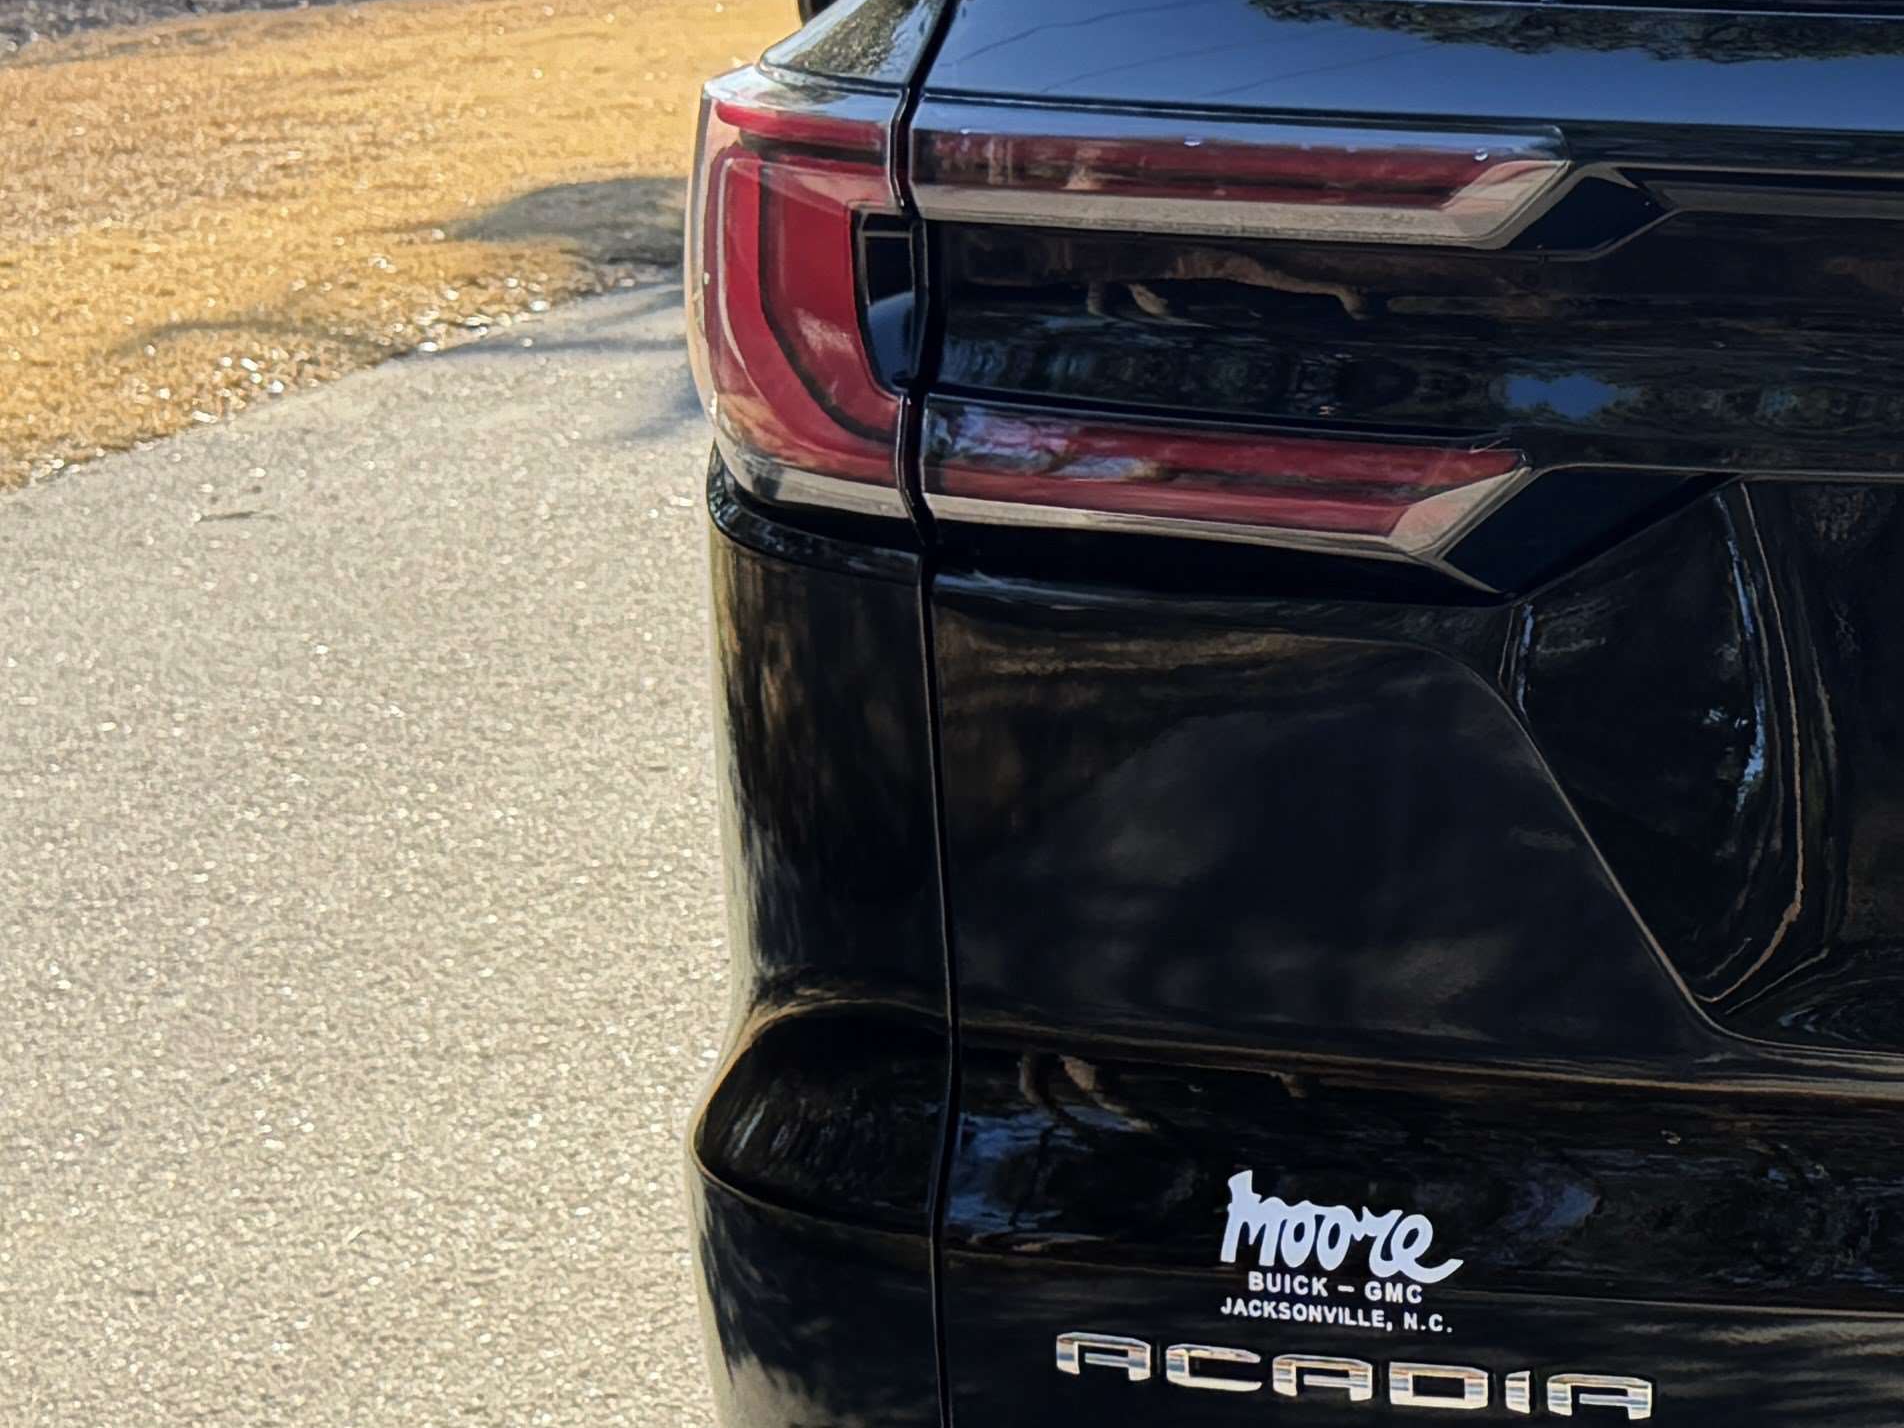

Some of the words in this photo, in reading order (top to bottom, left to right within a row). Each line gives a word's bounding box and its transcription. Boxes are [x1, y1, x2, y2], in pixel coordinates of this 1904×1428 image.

[1248, 1270, 1329, 1298] BUICK
[1364, 1279, 1423, 1305] GMC
[1220, 1297, 1394, 1332] JACKSONVILLE,
[1403, 1310, 1454, 1333] N.C.
[1055, 1330, 1653, 1421] ACADIA
